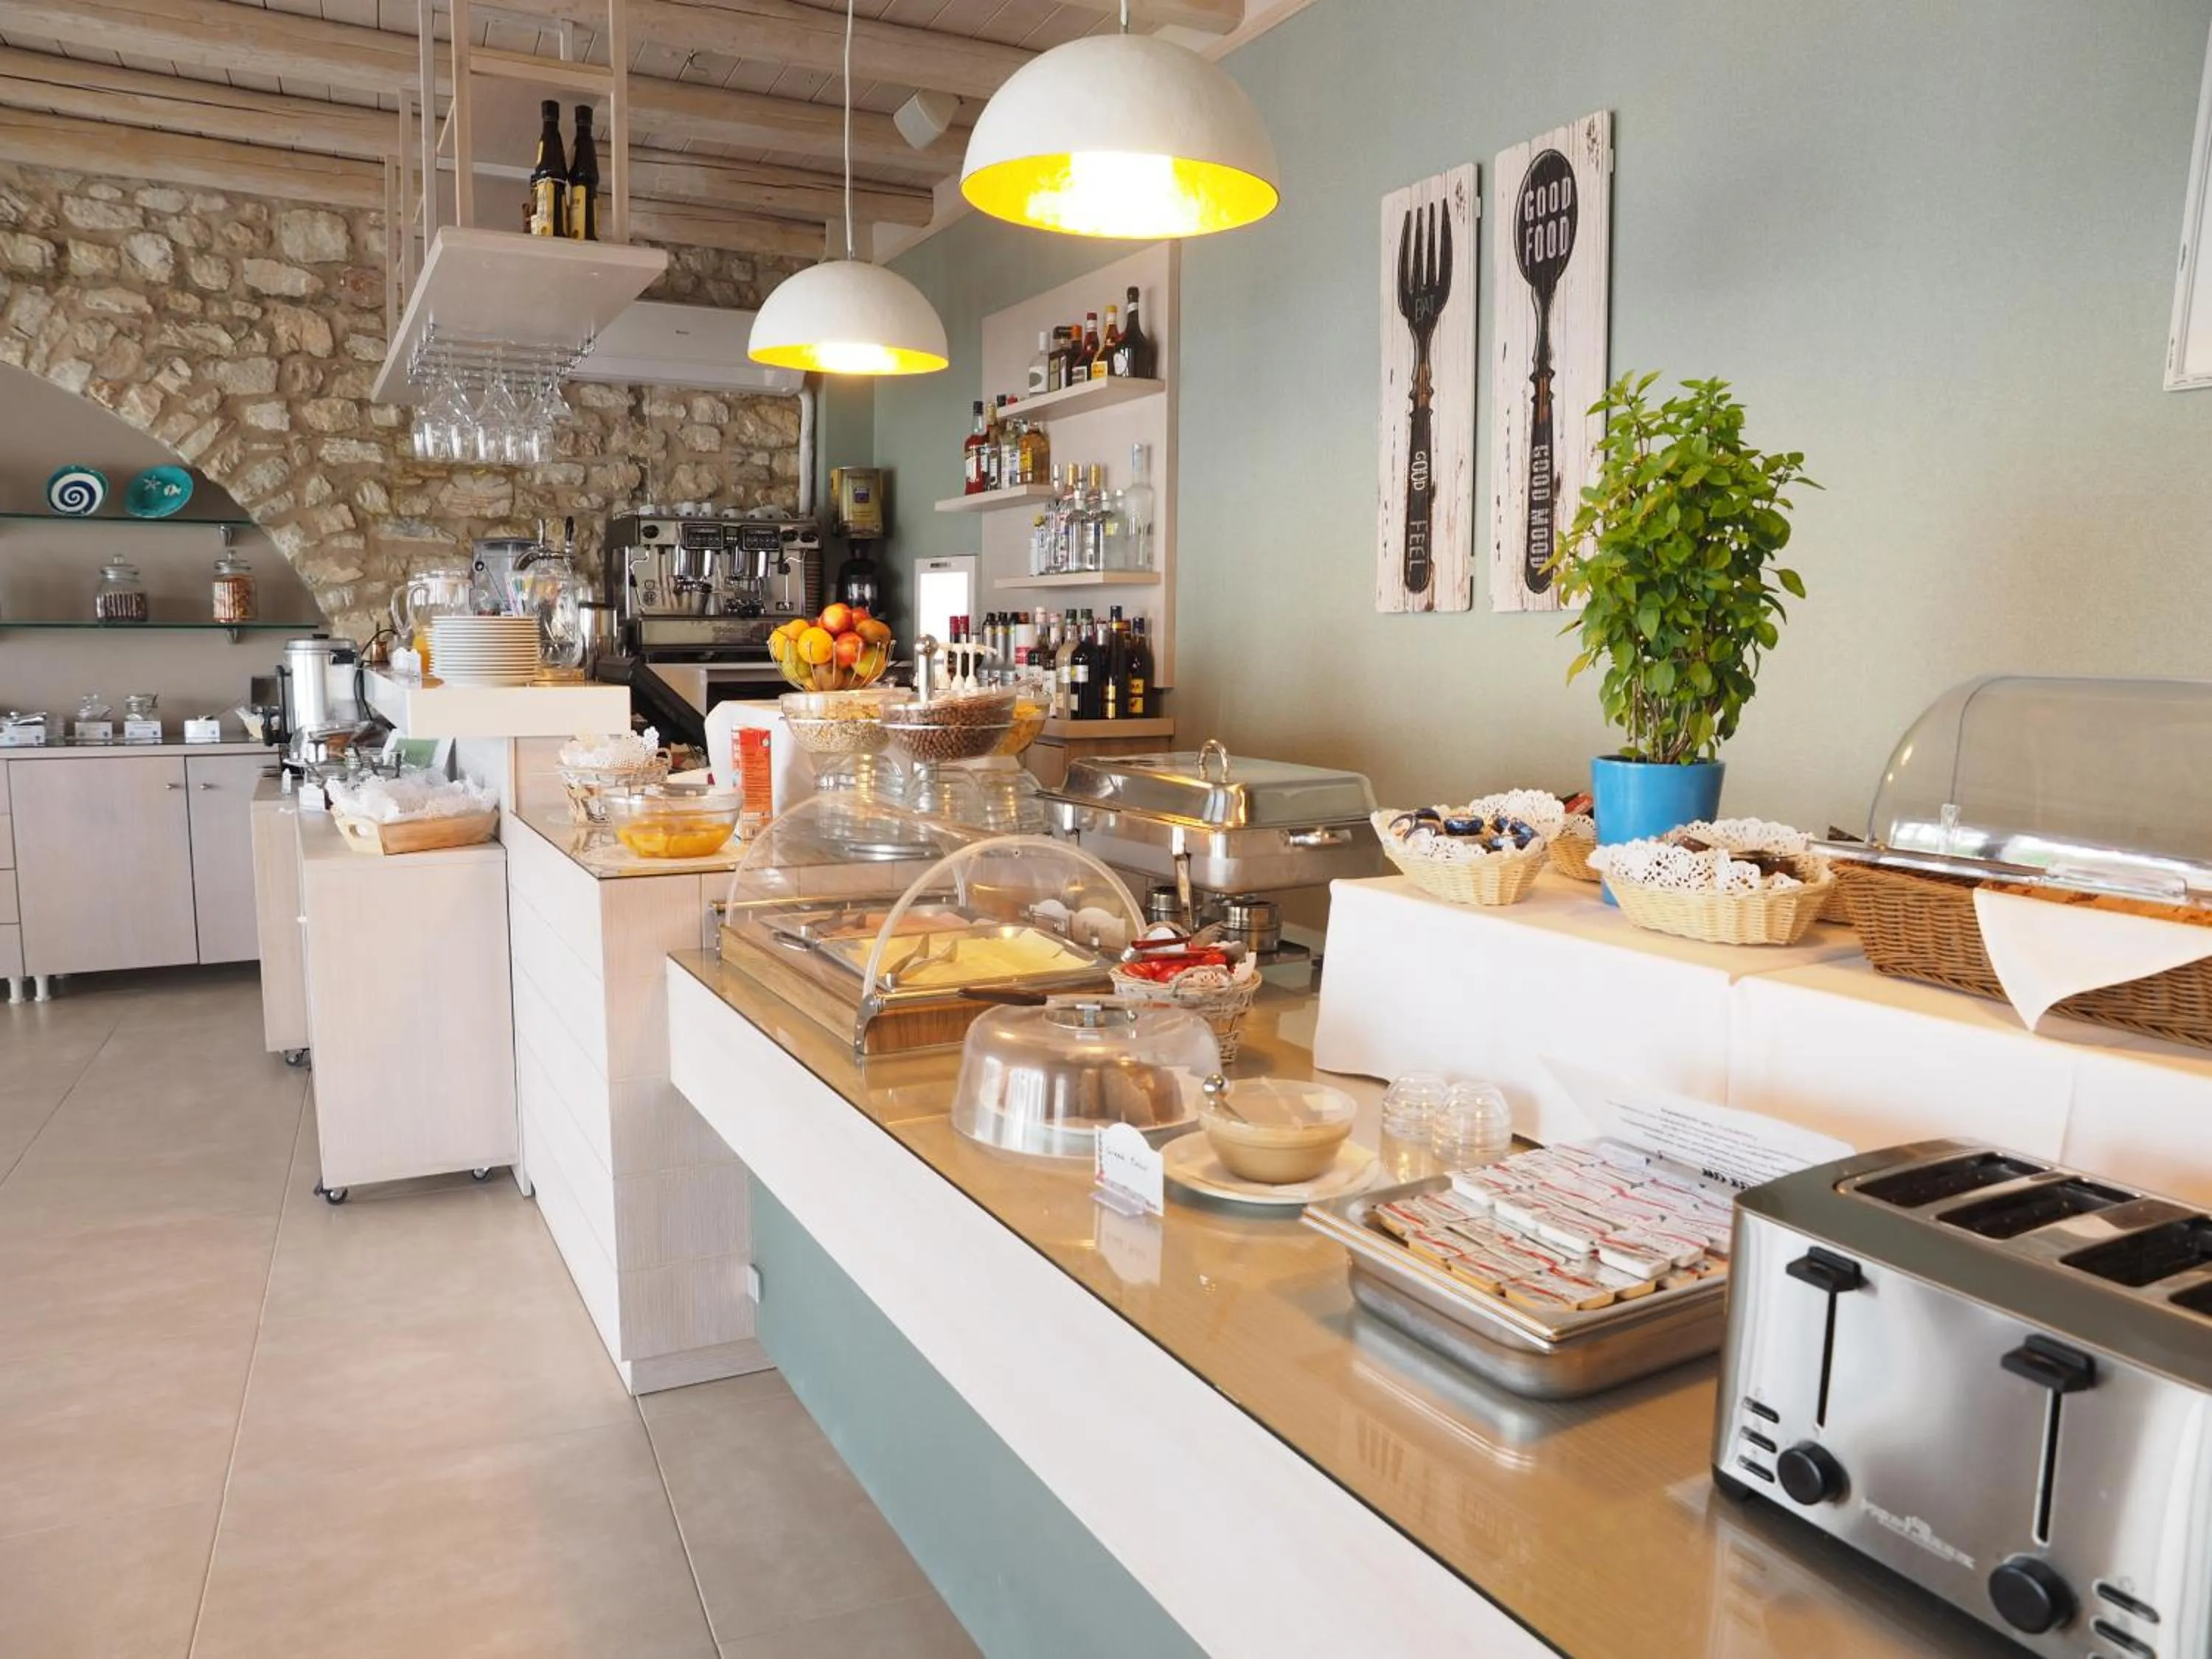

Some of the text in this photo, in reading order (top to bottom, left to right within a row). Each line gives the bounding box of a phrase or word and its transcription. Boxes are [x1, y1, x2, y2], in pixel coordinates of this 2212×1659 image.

[1524, 176, 1571, 222] GOOD
[1525, 215, 1570, 266] FOOD
[1409, 451, 1428, 571] GOOD FEEL
[1530, 445, 1550, 568] GOOD MOOD
